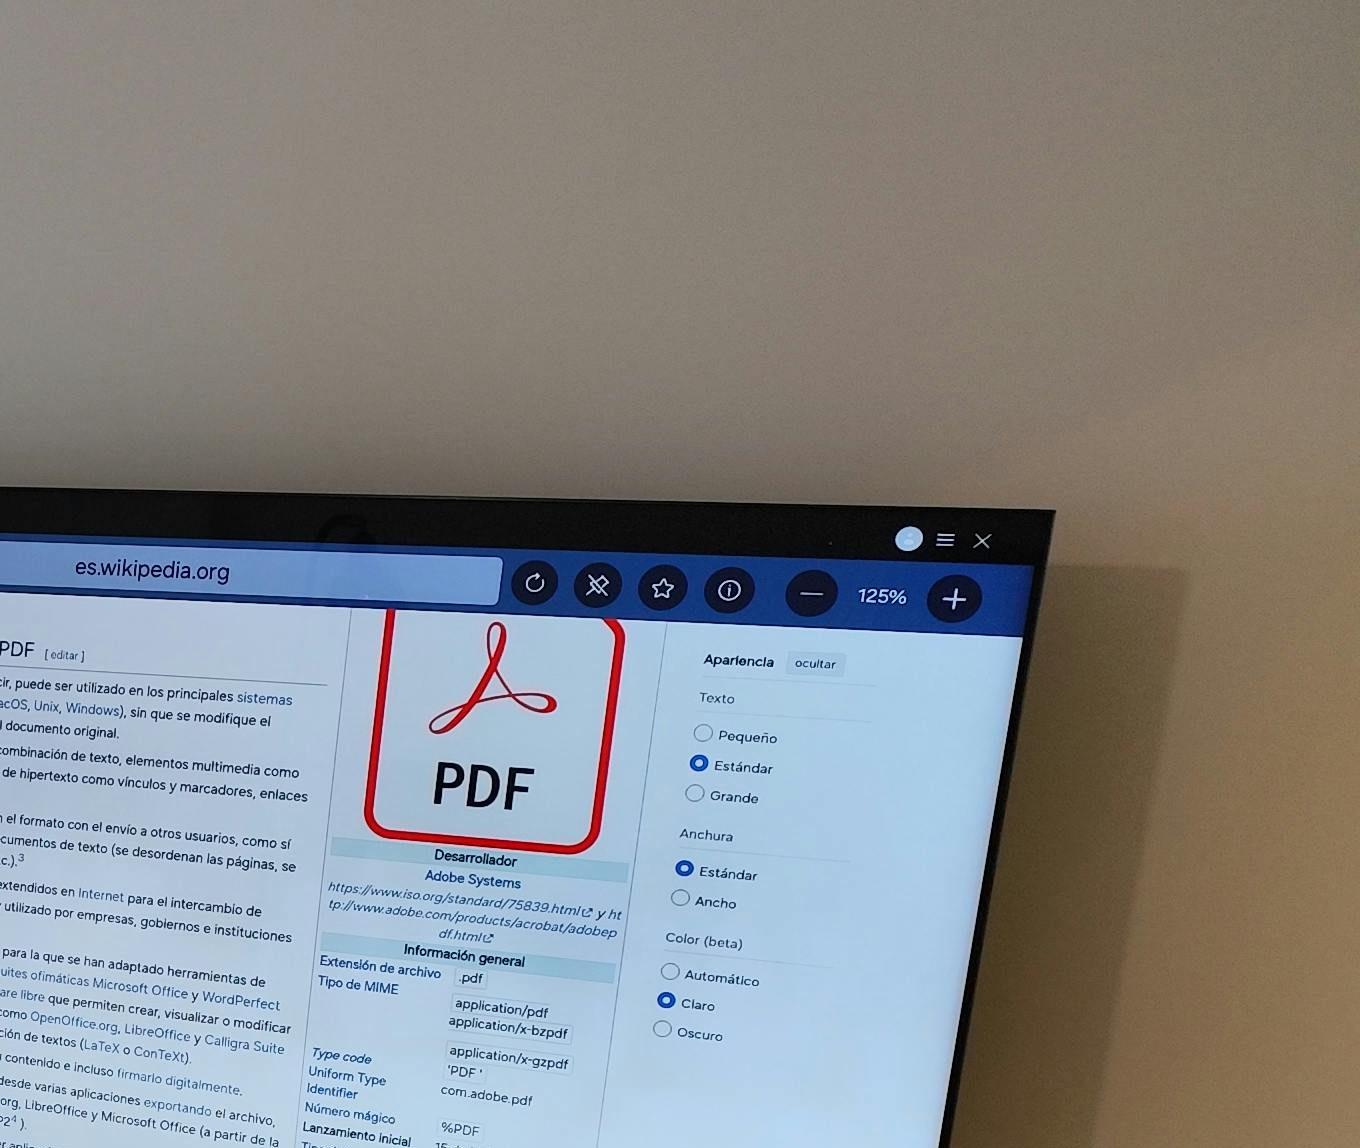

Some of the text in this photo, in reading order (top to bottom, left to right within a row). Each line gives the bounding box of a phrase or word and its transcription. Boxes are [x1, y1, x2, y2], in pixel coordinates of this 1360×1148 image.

[75, 558, 229, 585] es.wikipedia.org
[858, 588, 906, 604] 125%
[703, 654, 774, 667] Apariencia
[794, 659, 836, 669] ocultar
[14, 679, 51, 691] puede
[54, 682, 72, 691] ser
[76, 681, 125, 694] utilizado
[128, 686, 143, 696] en
[146, 685, 163, 697] los
[166, 687, 233, 703] principales
[236, 691, 292, 705] sistemas
[699, 692, 734, 704] Texto
[718, 730, 777, 744] Pequeño
[70, 750, 86, 761] de
[89, 752, 121, 766] texto,
[125, 754, 188, 769] elementos
[191, 760, 260, 775] multimedia
[263, 767, 299, 778] como
[714, 760, 773, 774] Estándar
[433, 761, 534, 810] PDF
[710, 790, 758, 803] Grande
[679, 828, 733, 841] Anchura
[434, 848, 517, 867] Desarrollador
[424, 869, 521, 889] Adobe Systems
[699, 866, 757, 880] Estándar
[694, 896, 736, 909] Ancho
[665, 932, 742, 951] Color (beta)
[403, 943, 525, 967] Información general
[2, 948, 26, 959] para
[30, 949, 39, 960] la
[42, 953, 64, 964] que
[67, 956, 80, 965] se
[83, 955, 104, 968] han
[107, 959, 163, 975] adaptado
[167, 965, 246, 985] herramientas
[249, 975, 265, 987] de
[319, 954, 441, 978] Extensión de archivo
[317, 974, 399, 994] Tipo de MIME
[684, 969, 759, 986] Automático
[455, 999, 548, 1018] application/pdf
[681, 998, 715, 1011] Claro
[448, 1017, 568, 1039] application/x-bzpdf
[677, 1027, 722, 1041] Oscuro
[312, 1047, 371, 1064] Type code
[449, 1047, 568, 1070] application/x-gzpdf
[4, 1054, 60, 1069] contenido
[63, 1062, 70, 1070] e
[73, 1061, 113, 1077] incluso
[117, 1068, 162, 1083] firmarlo
[165, 1075, 242, 1096] digitalmente.
[308, 1065, 386, 1087] Uniform Type
[306, 1082, 358, 1099] Identifier
[440, 1086, 533, 1106] com.adobe.pdf
[304, 1101, 395, 1124] Número mágico
[302, 1121, 411, 1147] Lanzamiento inicial
[441, 1121, 479, 1136] %PDF
